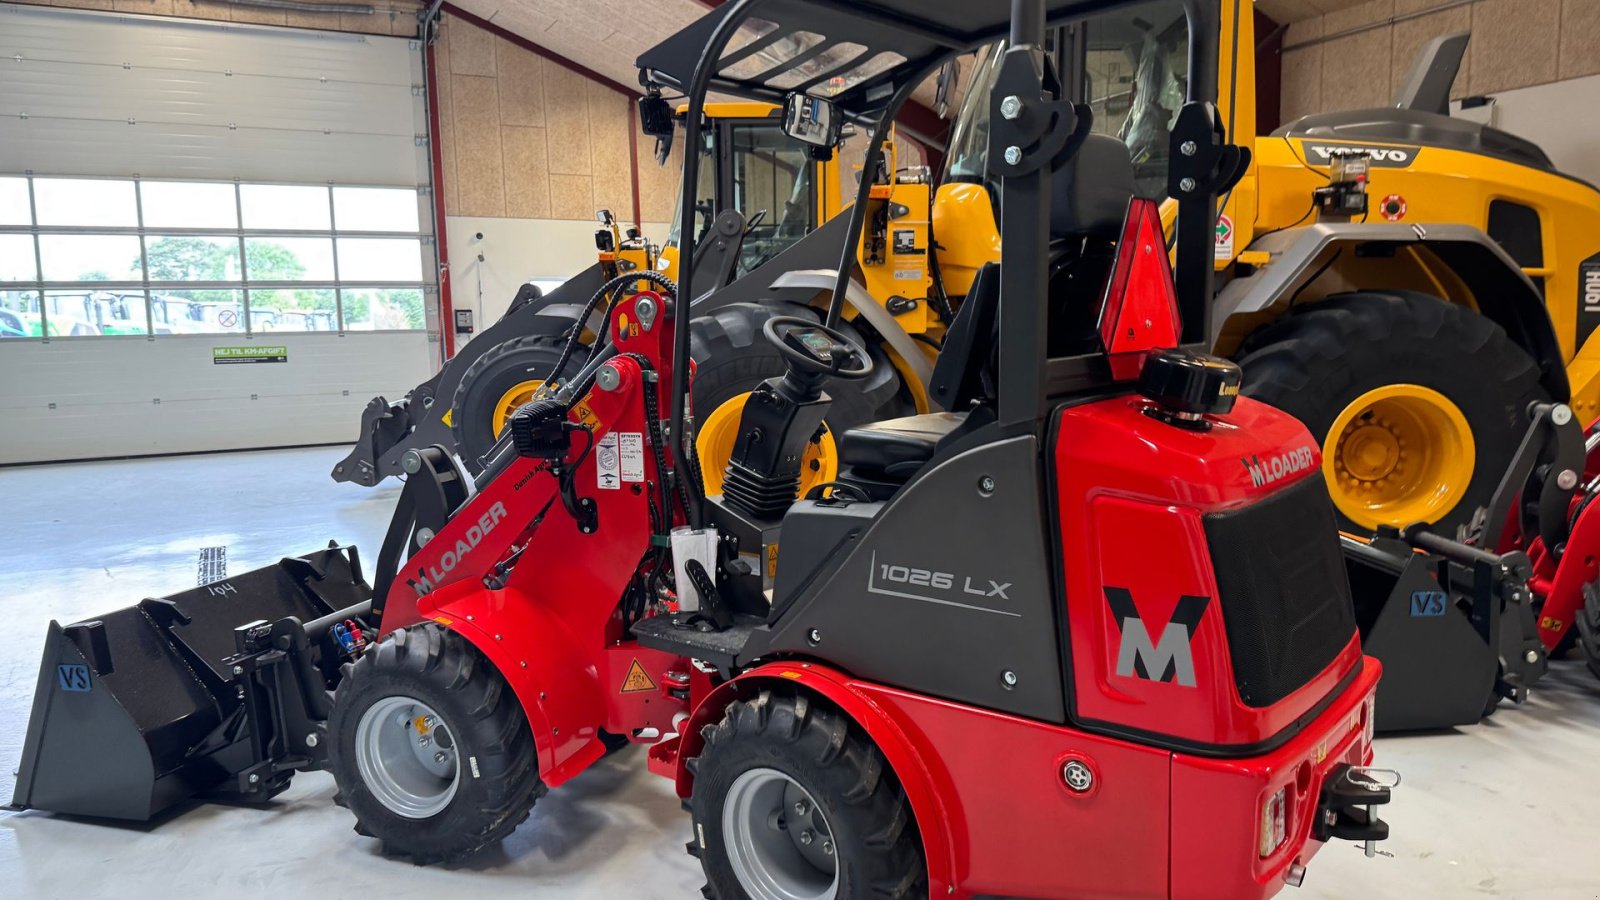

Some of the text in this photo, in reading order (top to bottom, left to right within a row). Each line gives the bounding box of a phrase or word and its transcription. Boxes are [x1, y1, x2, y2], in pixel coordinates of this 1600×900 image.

[881, 564, 1013, 600] 1026 LX
[1414, 593, 1443, 614] VS
[60, 666, 87, 690] VS
